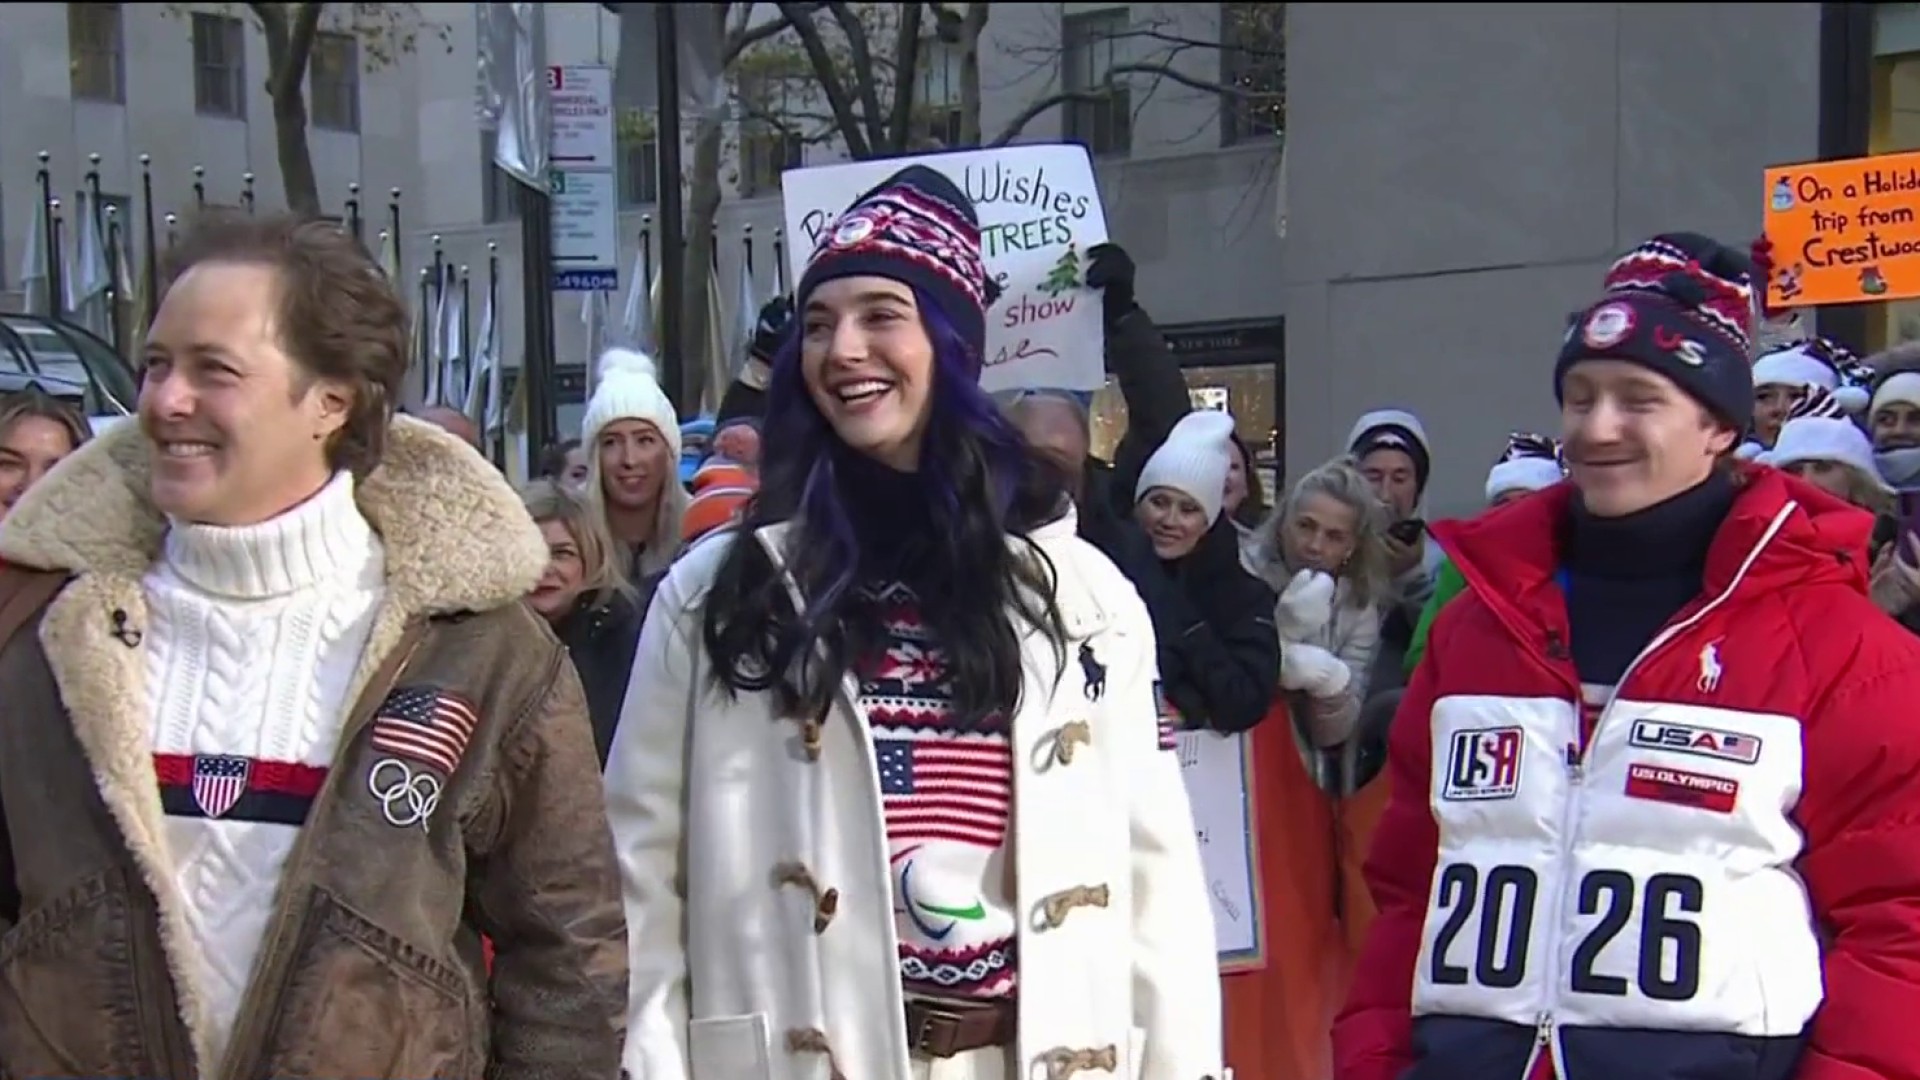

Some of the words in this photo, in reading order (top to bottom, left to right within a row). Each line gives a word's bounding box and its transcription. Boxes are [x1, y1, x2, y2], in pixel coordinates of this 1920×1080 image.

[965, 160, 1089, 219] Wishes
[1798, 176, 1832, 202] On
[1843, 185, 1857, 198] a
[1864, 168, 1920, 195] Holid
[980, 215, 1072, 258] TREES
[1811, 209, 1848, 234] trip
[1857, 205, 1914, 227] from
[1004, 293, 1076, 328] show
[1637, 723, 1719, 751] USA
[1452, 732, 1518, 788] USA
[1656, 771, 1735, 794] OLYMPIC
[1432, 862, 1538, 989] 20
[1570, 869, 1704, 1003] 26
